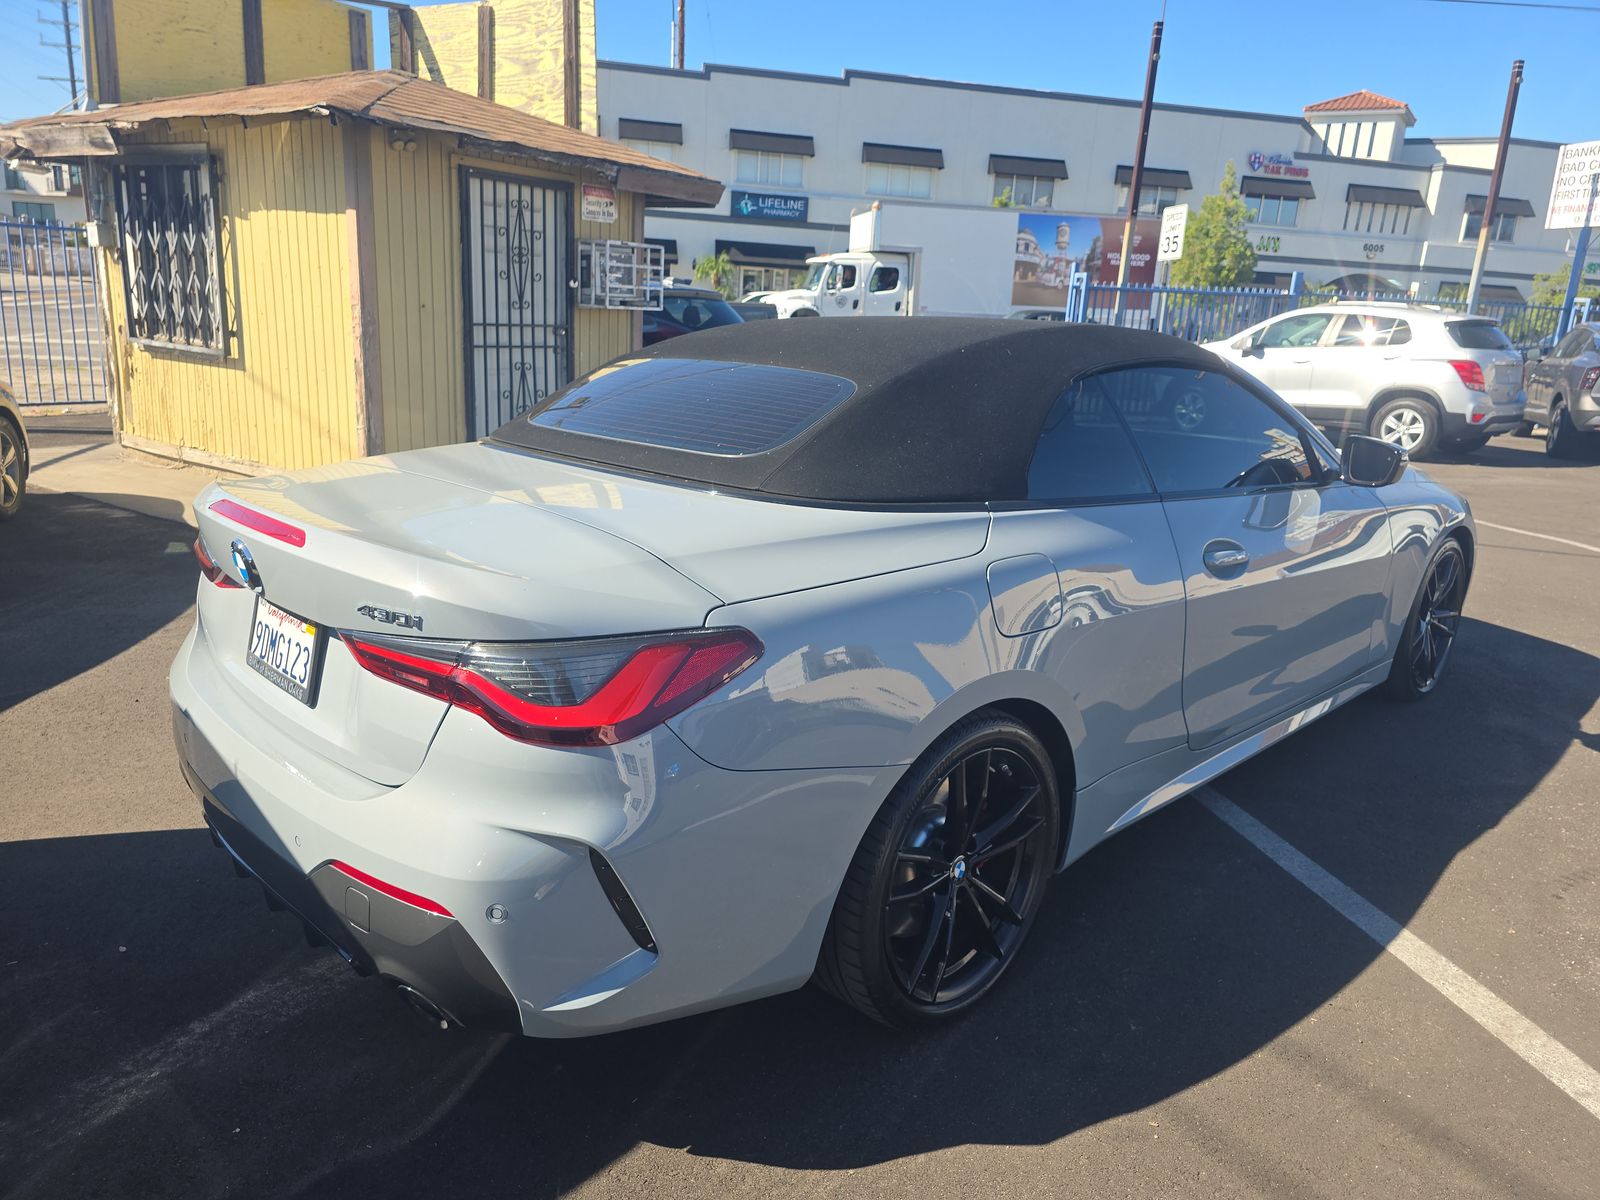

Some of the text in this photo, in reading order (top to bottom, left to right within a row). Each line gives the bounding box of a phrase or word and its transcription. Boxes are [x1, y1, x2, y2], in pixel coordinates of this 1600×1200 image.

[1285, 166, 1309, 178] PROS
[1562, 159, 1600, 173] BAD C
[1559, 176, 1576, 187] NO
[1556, 189, 1581, 201] FIRST
[759, 197, 804, 210] LIFELINE
[763, 208, 800, 217] PHARMACY
[1167, 212, 1183, 221] SPEED
[1165, 223, 1181, 234] LIMIT
[1163, 235, 1179, 253] 35
[1363, 243, 1385, 253] 6005
[1107, 252, 1151, 261] HOLWOOD
[357, 605, 424, 632] 430i
[252, 621, 311, 685] 9DMG123
[263, 666, 288, 690] SHERMAN
[288, 681, 303, 700] OAKS
